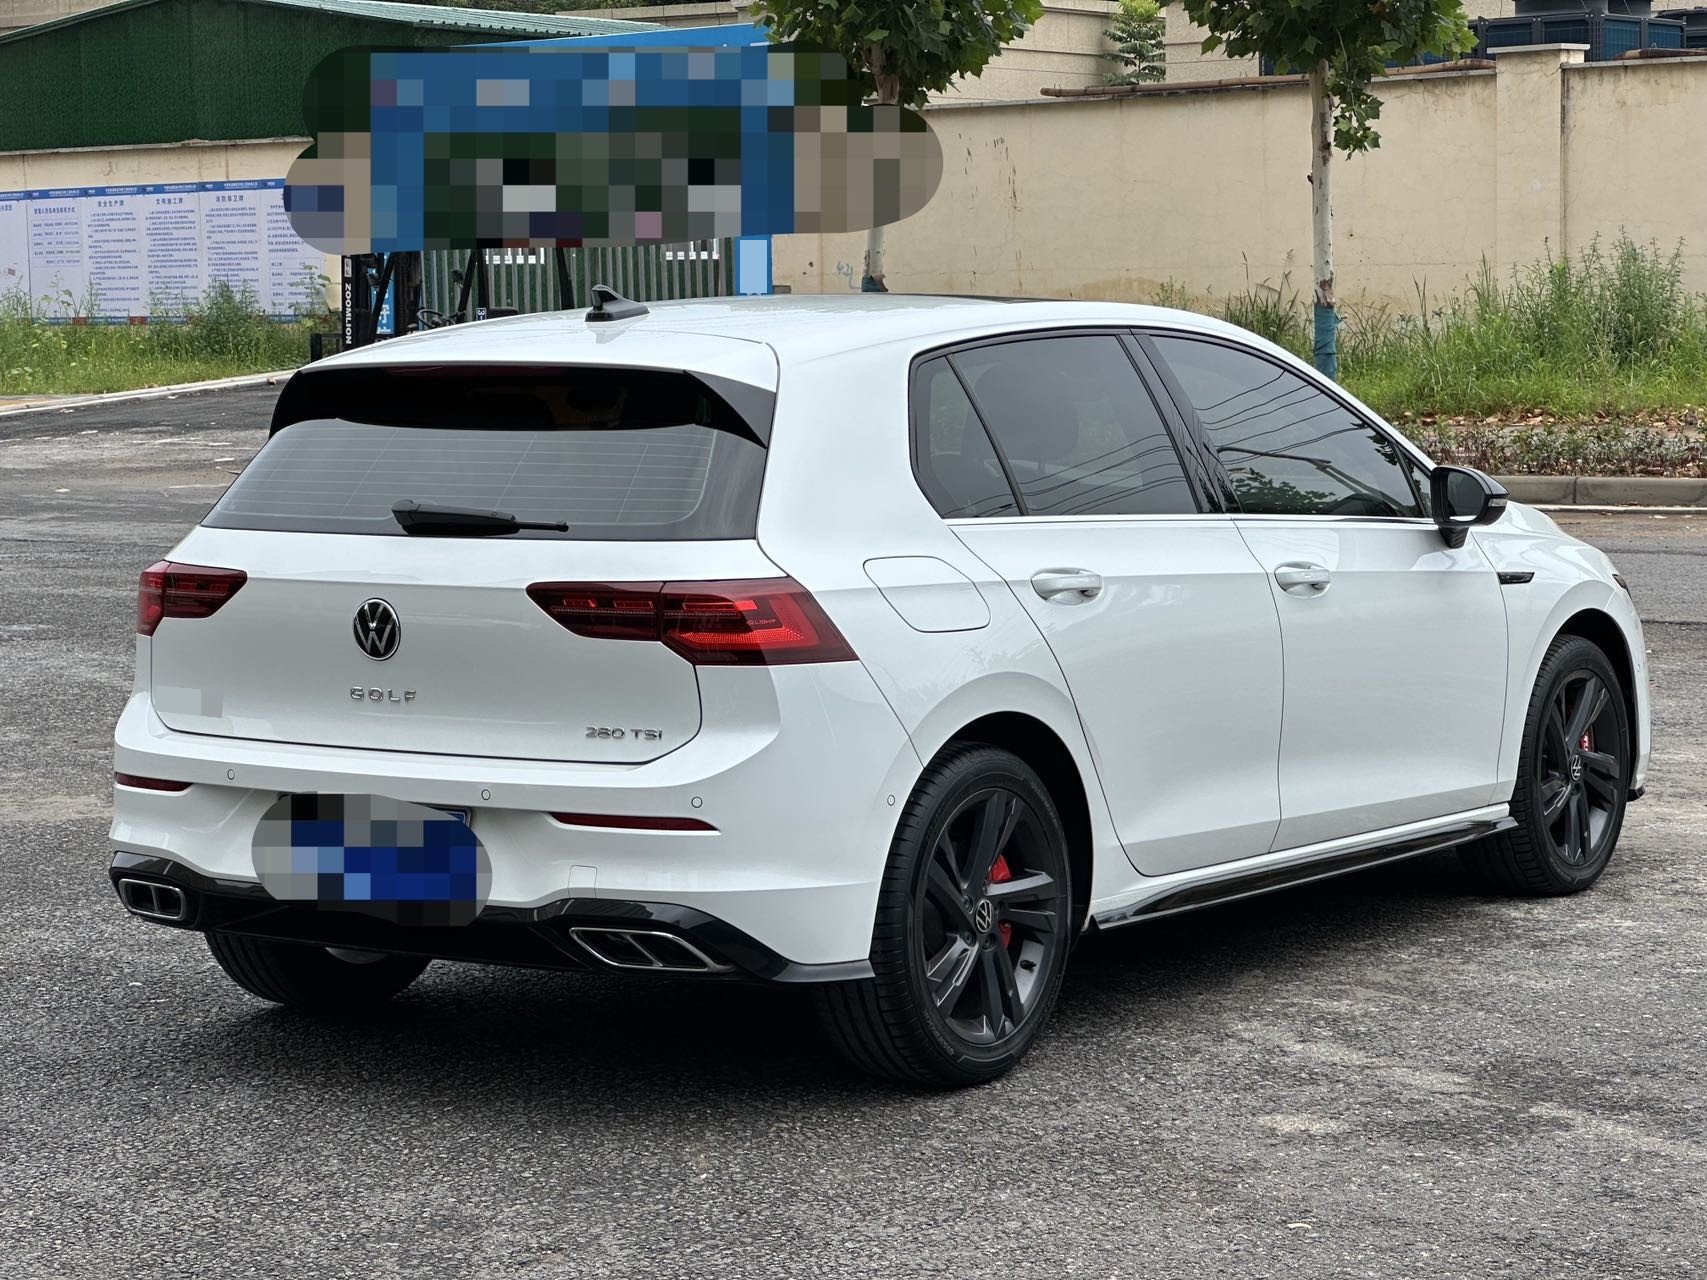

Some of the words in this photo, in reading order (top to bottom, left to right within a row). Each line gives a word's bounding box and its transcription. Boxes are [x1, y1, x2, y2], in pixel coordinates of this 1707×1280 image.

[350, 686, 417, 703] GOLF
[585, 726, 625, 740] 280
[630, 727, 664, 741] TSI
